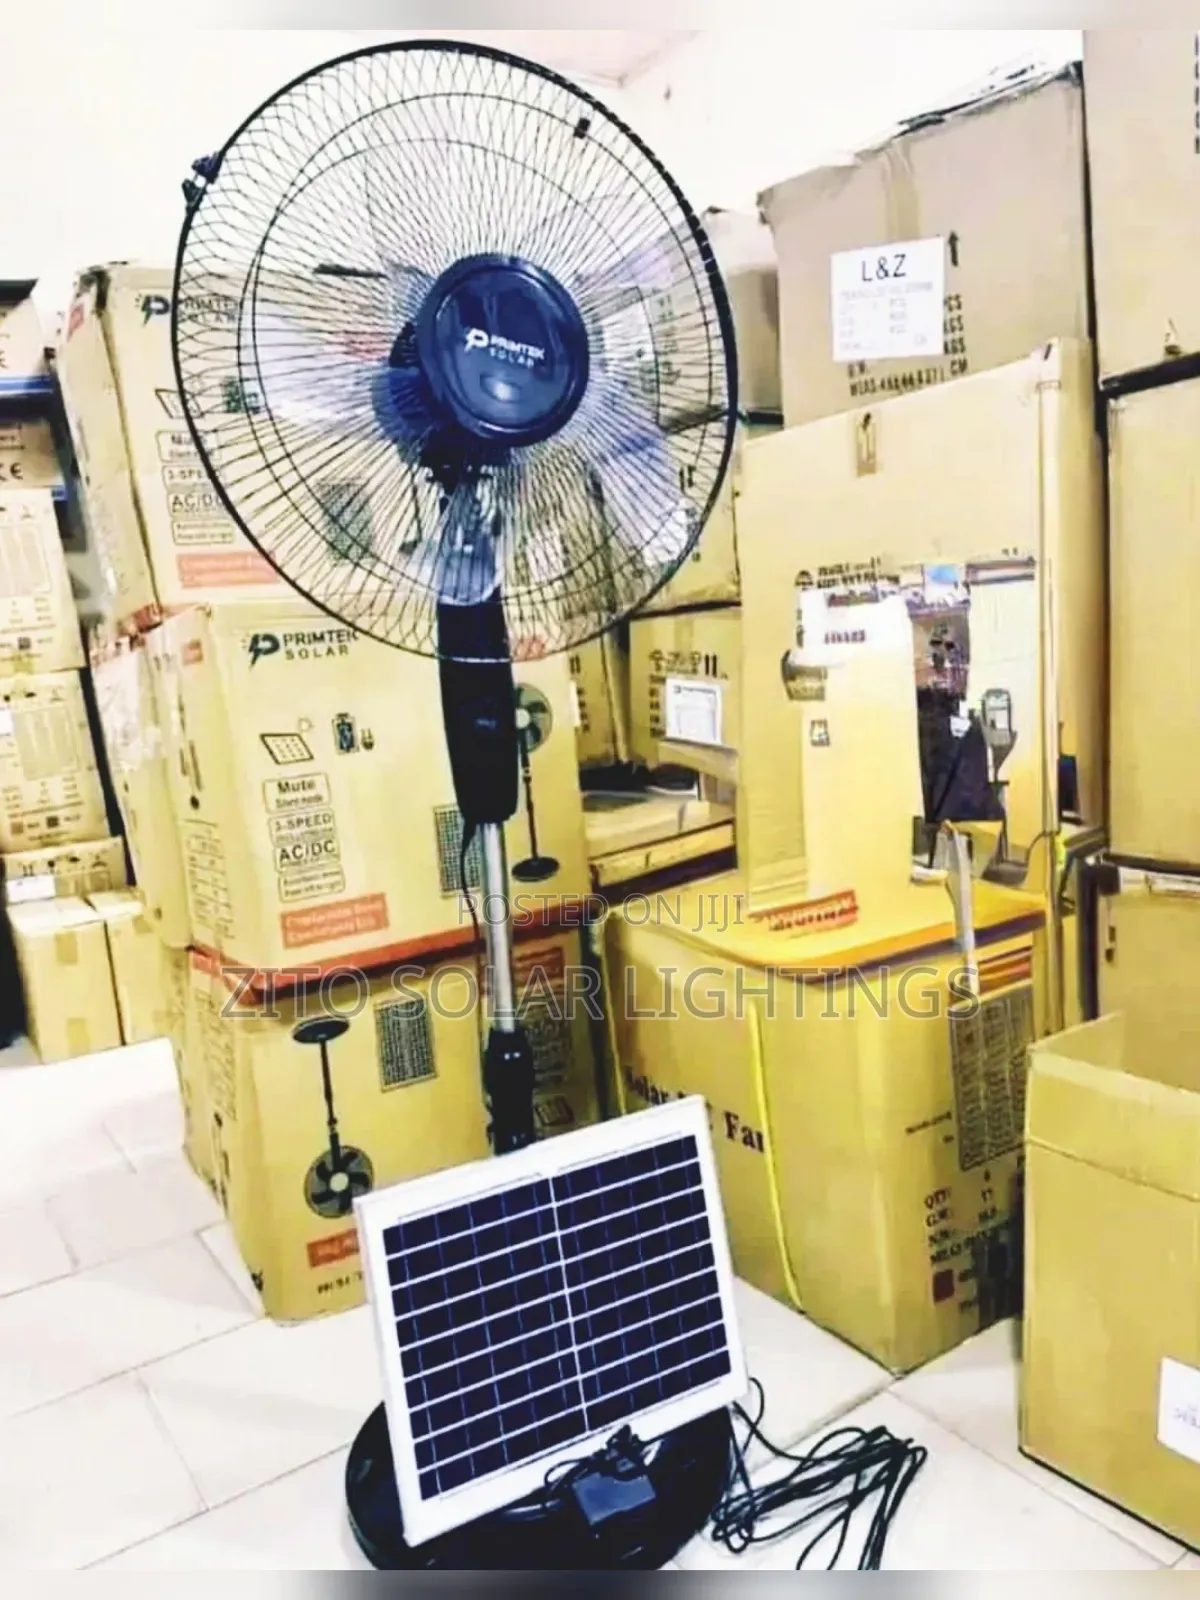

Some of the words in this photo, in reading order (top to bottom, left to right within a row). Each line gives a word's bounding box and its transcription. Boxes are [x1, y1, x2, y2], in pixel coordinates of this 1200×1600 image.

[861, 254, 906, 282] L&Z
[285, 645, 349, 660] SOLAR
[277, 780, 316, 794] Mute
[279, 840, 336, 862] AC/DC
